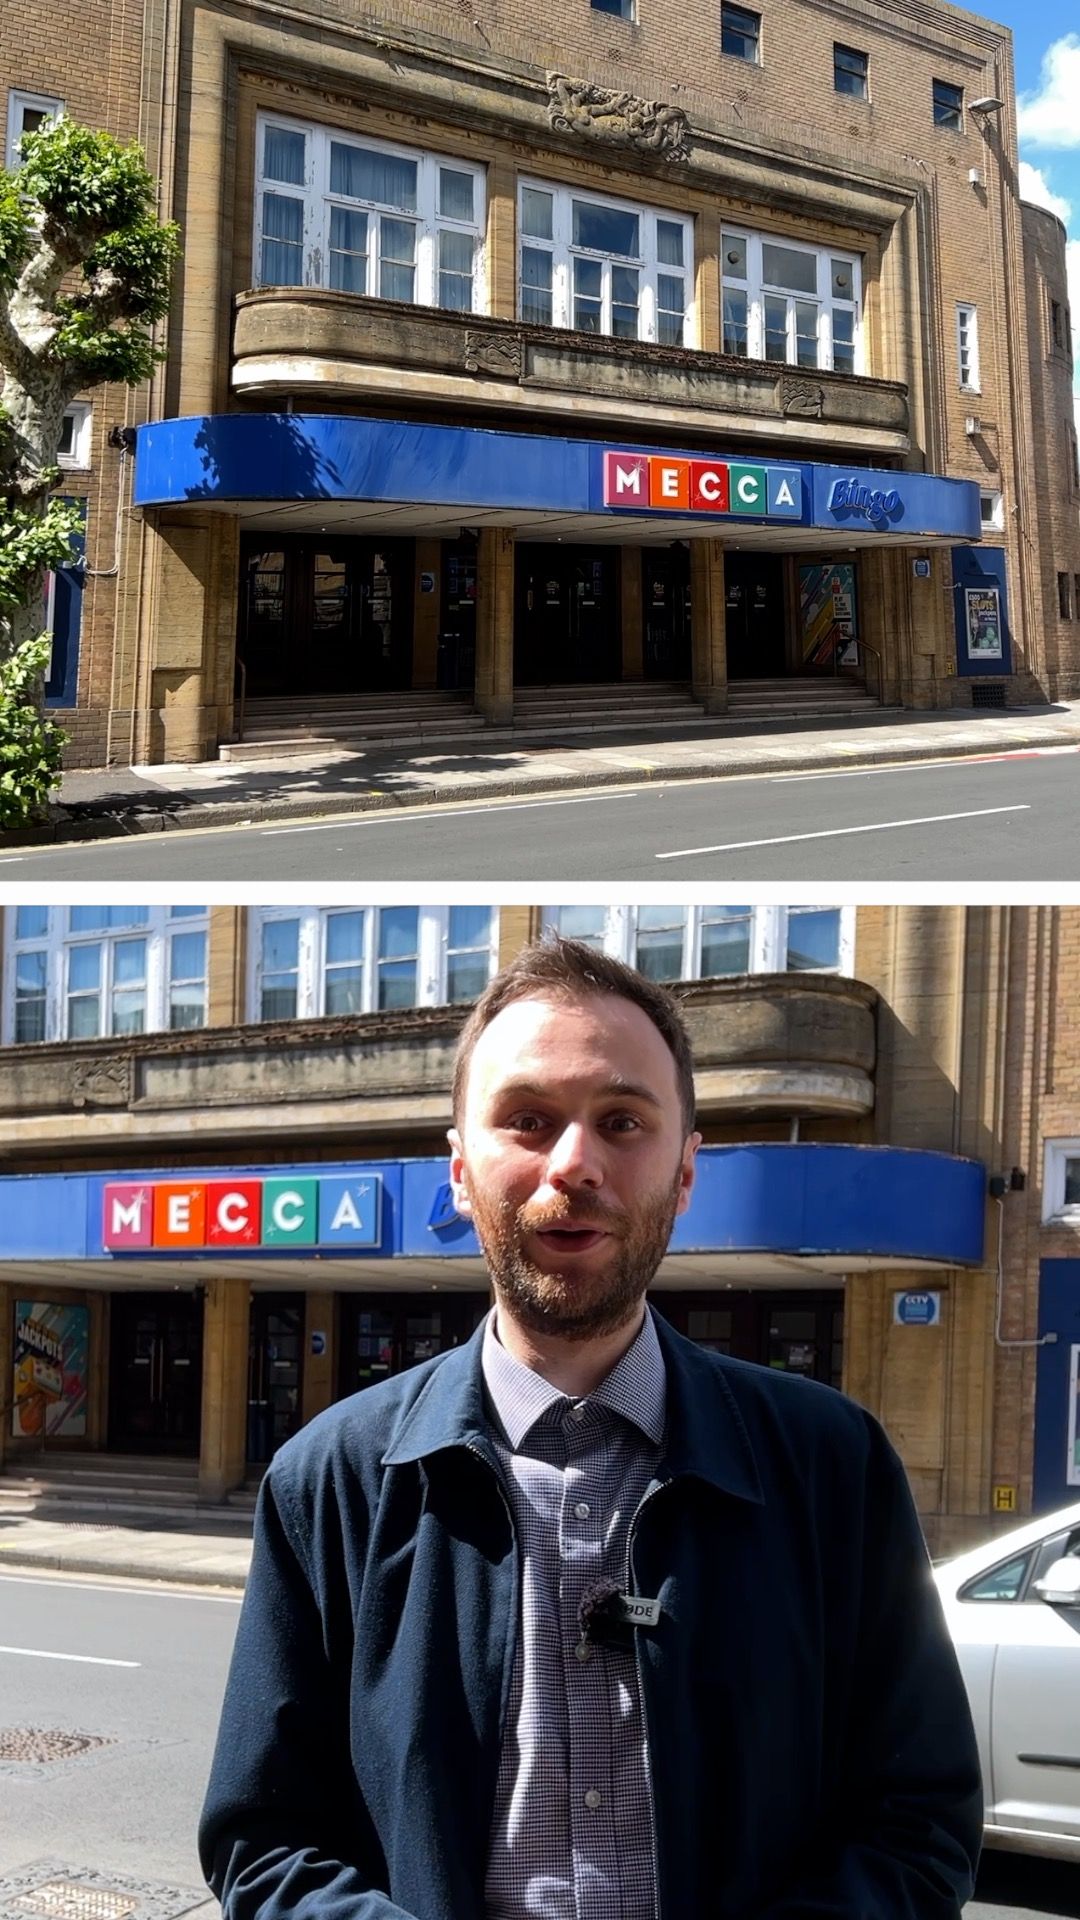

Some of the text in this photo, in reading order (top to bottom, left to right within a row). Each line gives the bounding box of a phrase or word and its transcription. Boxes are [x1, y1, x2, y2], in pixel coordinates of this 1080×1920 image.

[616, 464, 900, 520] MECCA Bingo
[112, 1190, 363, 1233] MECCA
[905, 1295, 928, 1304] CCTV
[996, 1490, 1012, 1508] H
